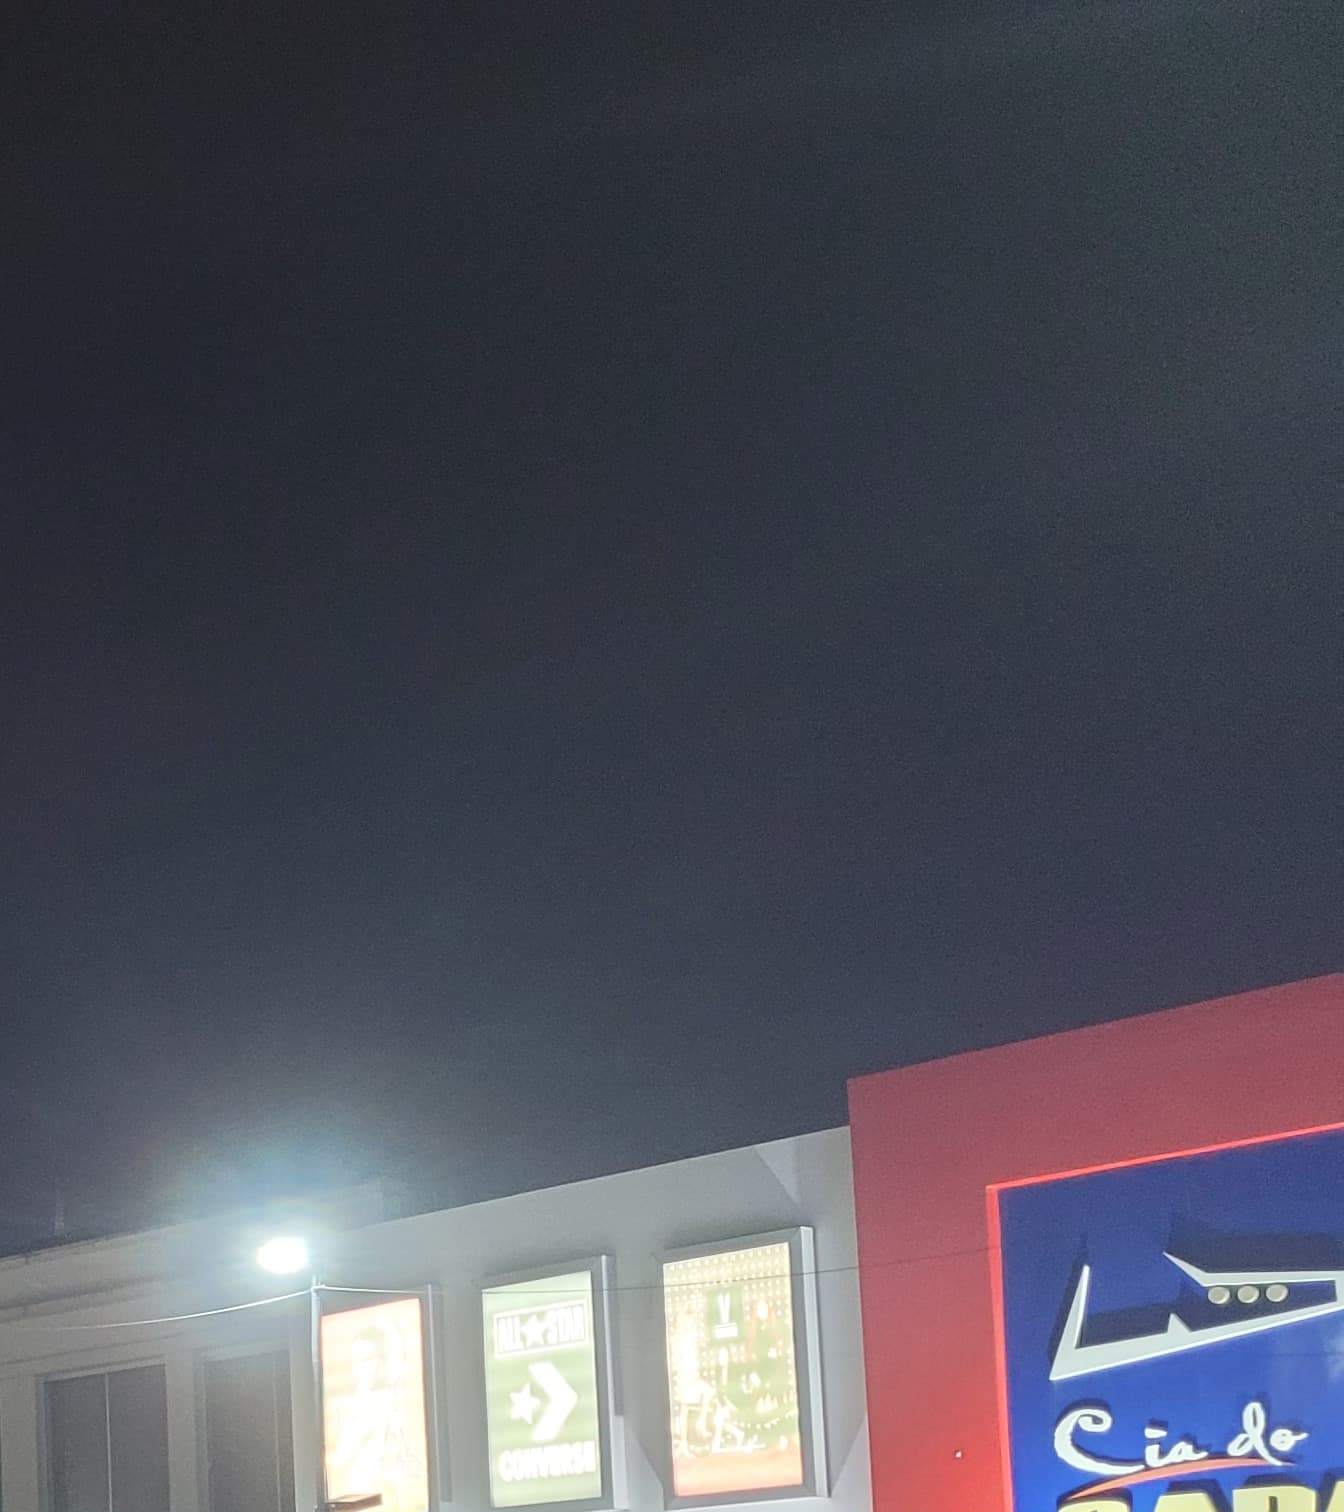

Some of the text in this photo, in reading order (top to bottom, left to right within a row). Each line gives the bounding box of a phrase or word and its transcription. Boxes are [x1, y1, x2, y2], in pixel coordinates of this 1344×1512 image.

[497, 1306, 584, 1353] ALL STAR
[498, 1440, 596, 1483] CONVERSE
[1054, 1402, 1309, 1475] Cia do
